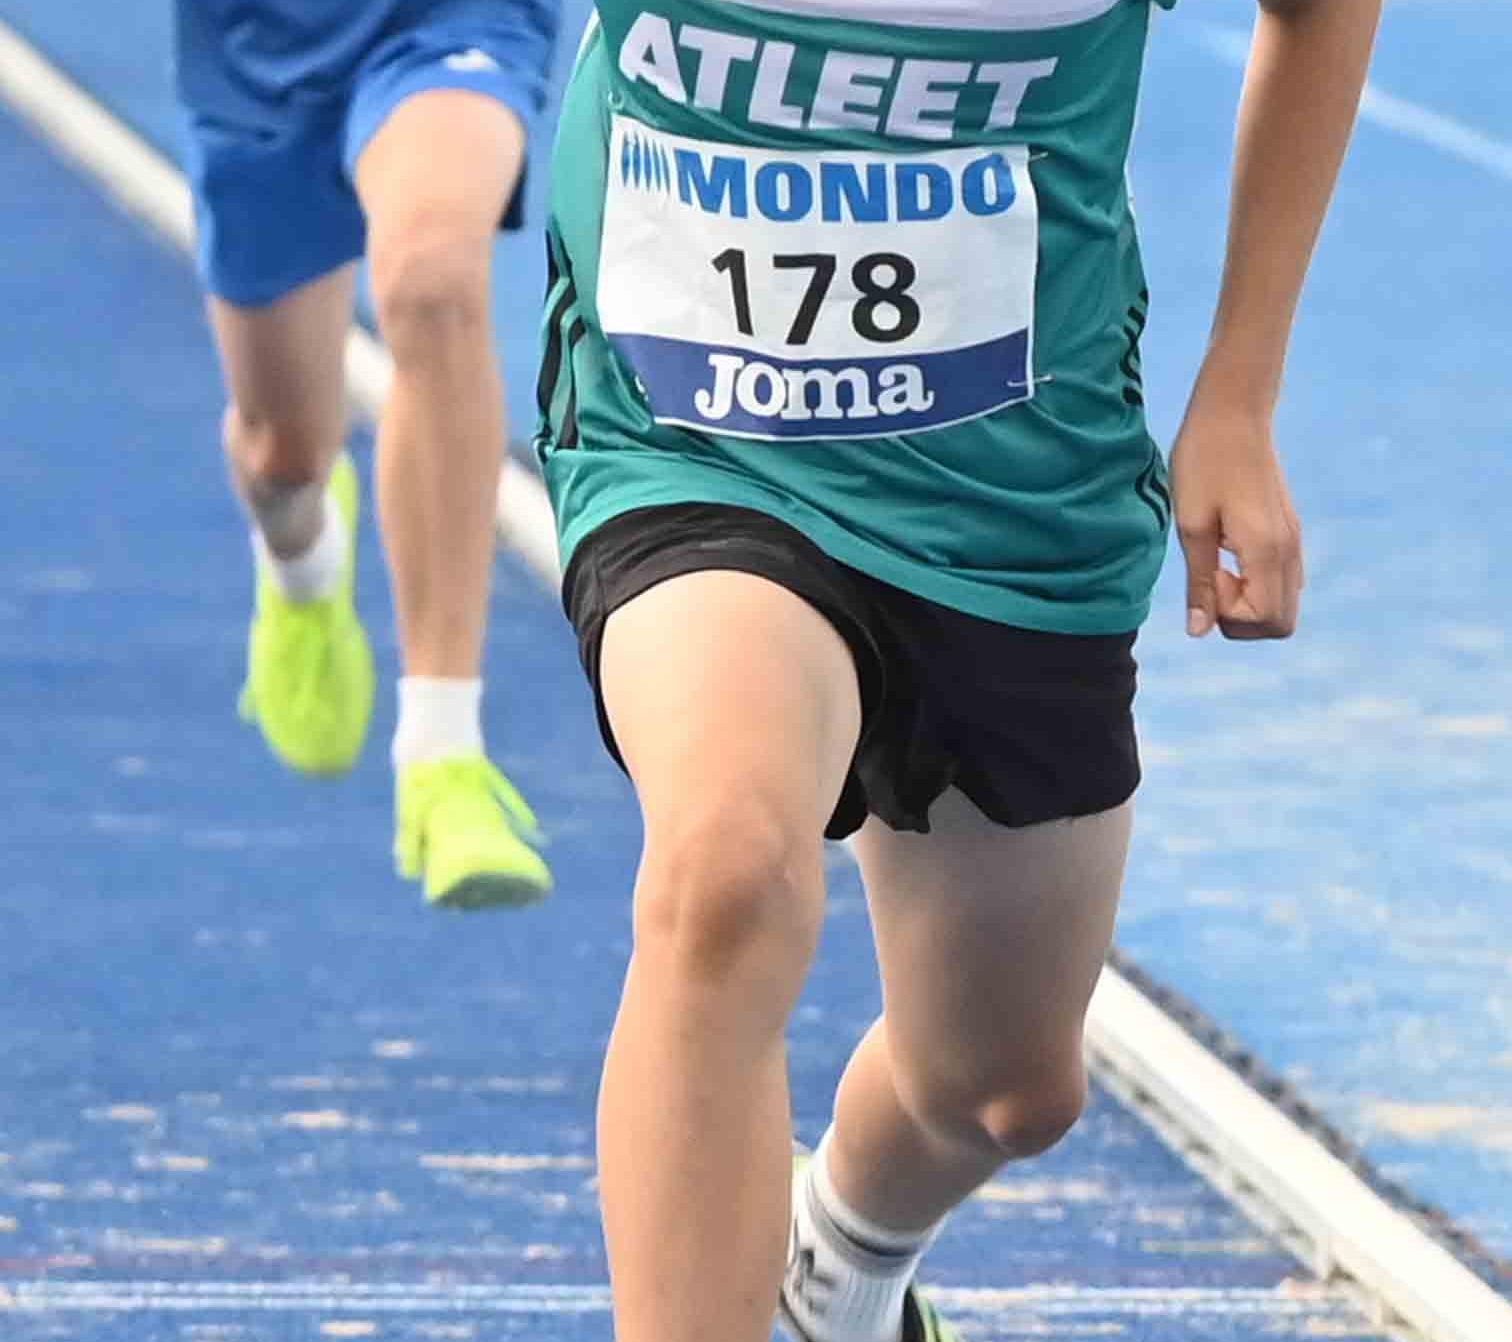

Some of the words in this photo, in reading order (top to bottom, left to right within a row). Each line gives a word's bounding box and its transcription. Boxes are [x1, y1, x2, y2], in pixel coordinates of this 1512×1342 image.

[619, 11, 1059, 140] ATLEET
[674, 147, 1017, 223] MONDO
[711, 247, 921, 346] 178
[694, 353, 934, 421] Joma
